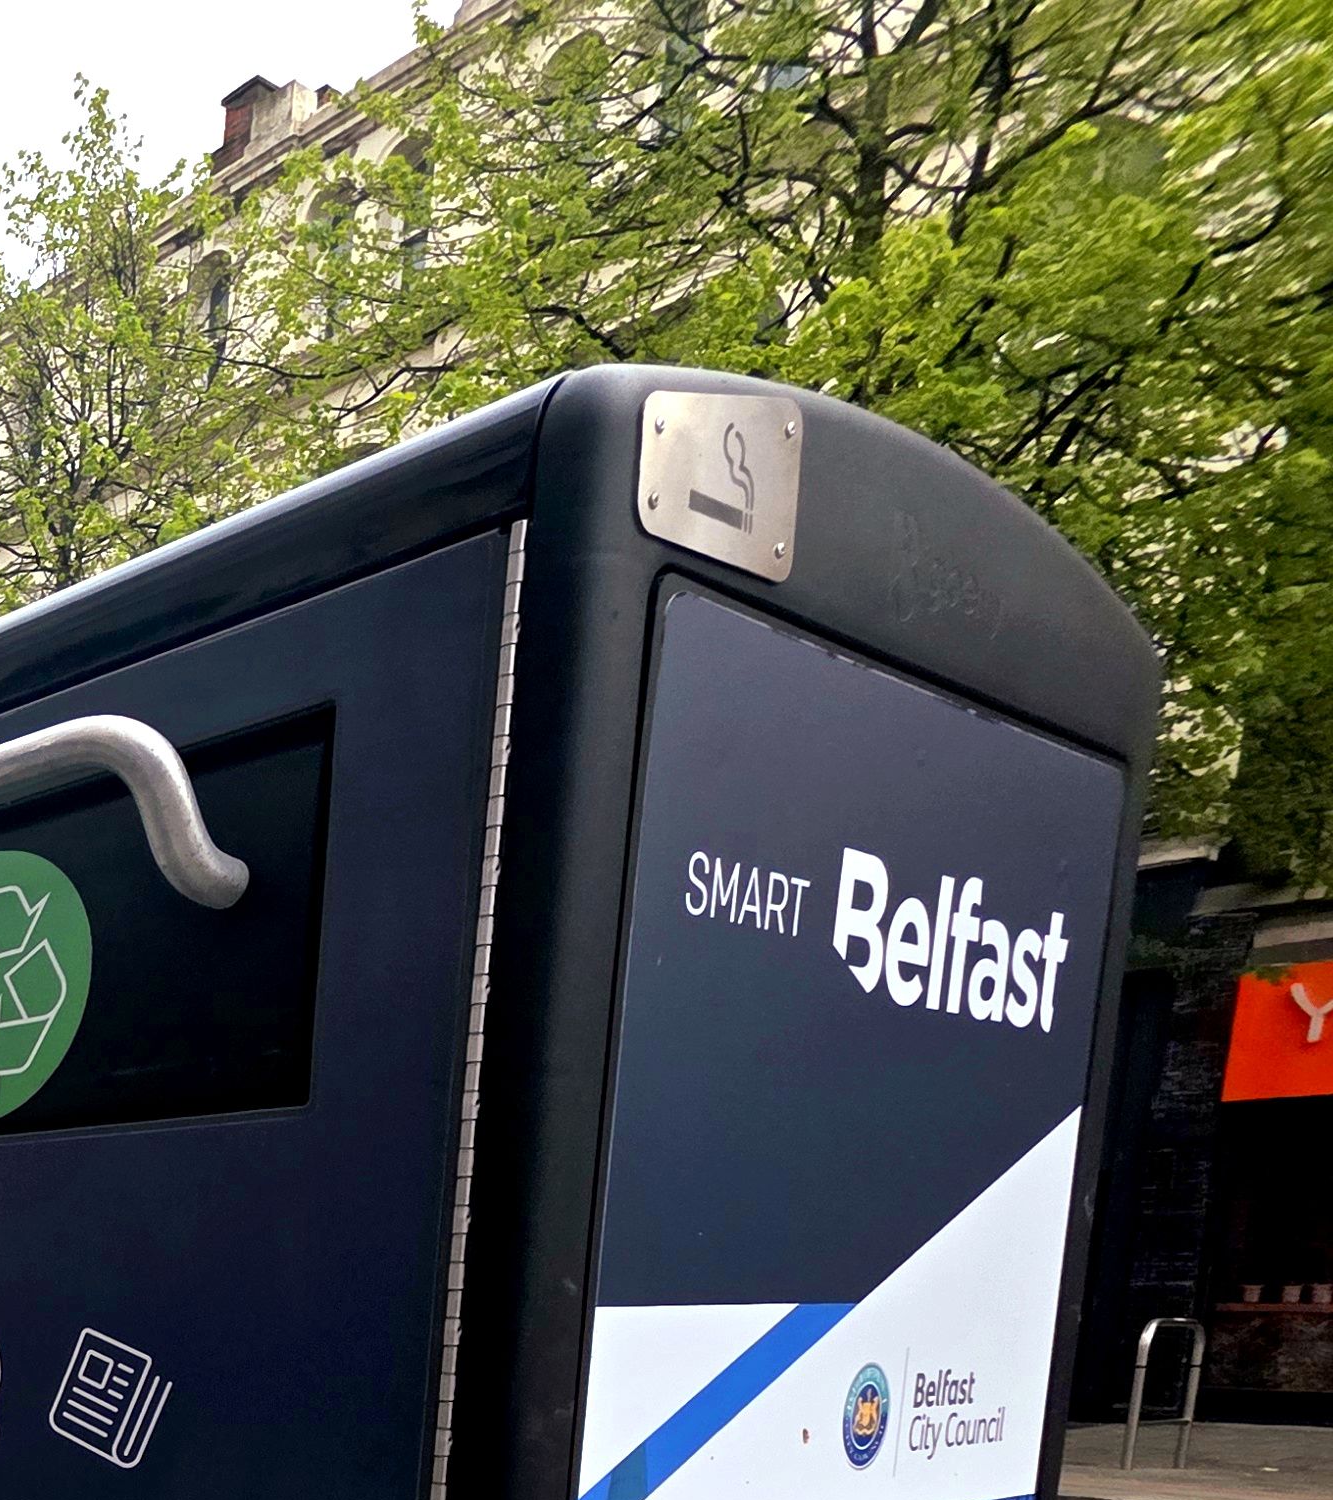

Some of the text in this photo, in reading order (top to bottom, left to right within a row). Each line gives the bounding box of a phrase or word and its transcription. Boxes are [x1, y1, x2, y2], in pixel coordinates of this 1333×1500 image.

[685, 847, 1069, 1032] SMART Belfast
[913, 1368, 976, 1409] Belfast
[909, 1413, 942, 1460] City
[945, 1406, 1006, 1448] Council
